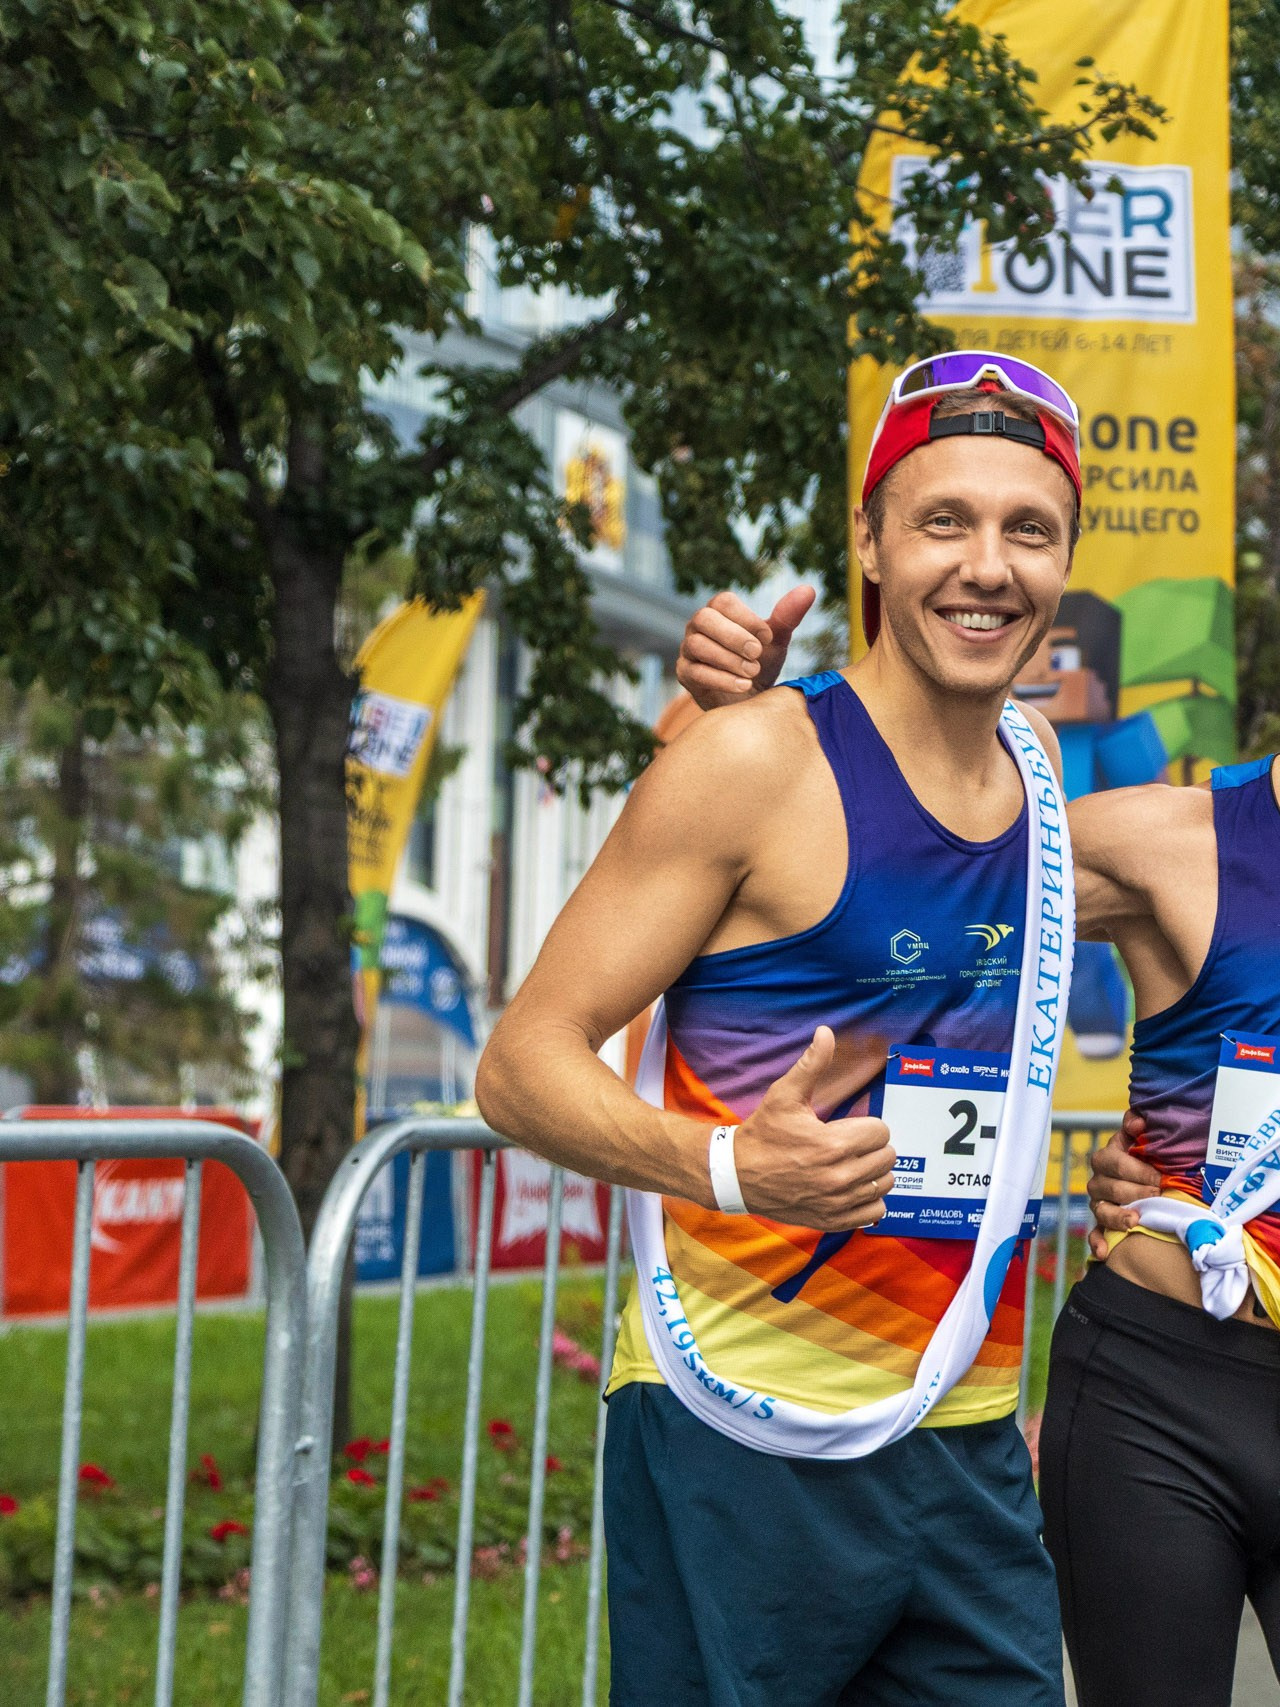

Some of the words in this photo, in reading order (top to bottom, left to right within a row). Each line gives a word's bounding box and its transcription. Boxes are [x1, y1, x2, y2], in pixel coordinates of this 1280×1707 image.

[1004, 245, 1172, 299] ONE
[996, 327, 1070, 351] ДЕТЕЙ
[1131, 334, 1173, 353] ЛЕТ
[1083, 464, 1199, 494] РСИЛА
[1083, 505, 1200, 537] УЩЕГО
[907, 941, 930, 950] УМПЦ
[885, 966, 926, 976] Уральский
[943, 1099, 997, 1156] 2-
[1223, 1135, 1246, 1145] 42.2
[894, 1159, 919, 1170] 2.2/5
[948, 1172, 992, 1187] ЭСТАФ
[887, 1210, 915, 1219] МАГНИТ
[918, 1208, 964, 1219] ДЕМИДОВЪ
